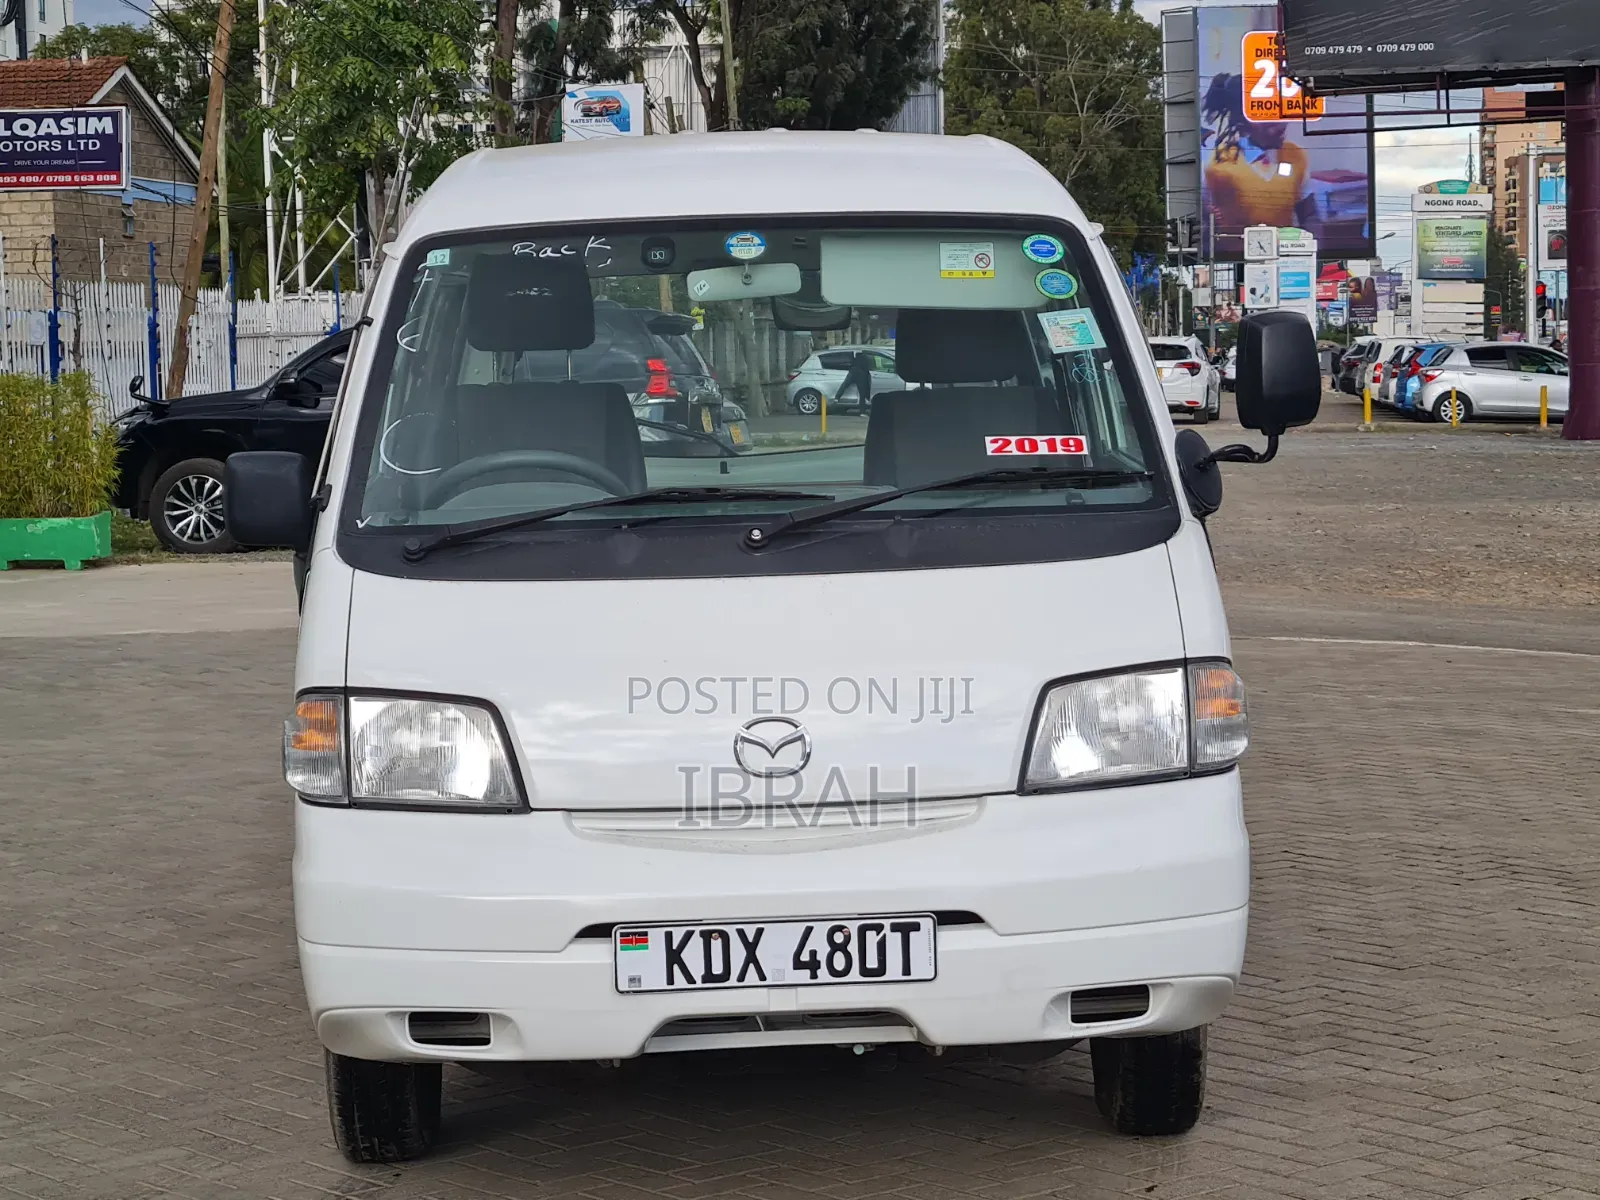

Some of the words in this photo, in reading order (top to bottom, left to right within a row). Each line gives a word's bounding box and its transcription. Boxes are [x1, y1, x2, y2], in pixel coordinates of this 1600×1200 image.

[1304, 46, 1327, 54] 0709
[1328, 45, 1344, 54] 479
[1346, 45, 1363, 53] 479
[1376, 44, 1398, 52] 0709
[1399, 43, 1416, 52] 479
[1418, 42, 1434, 51] 000
[1286, 99, 1318, 110] BANK
[67, 139, 101, 151] LTD
[433, 253, 446, 264] 12
[989, 437, 1084, 454] 2019
[664, 926, 767, 986] KDX
[792, 920, 921, 980] 480T
